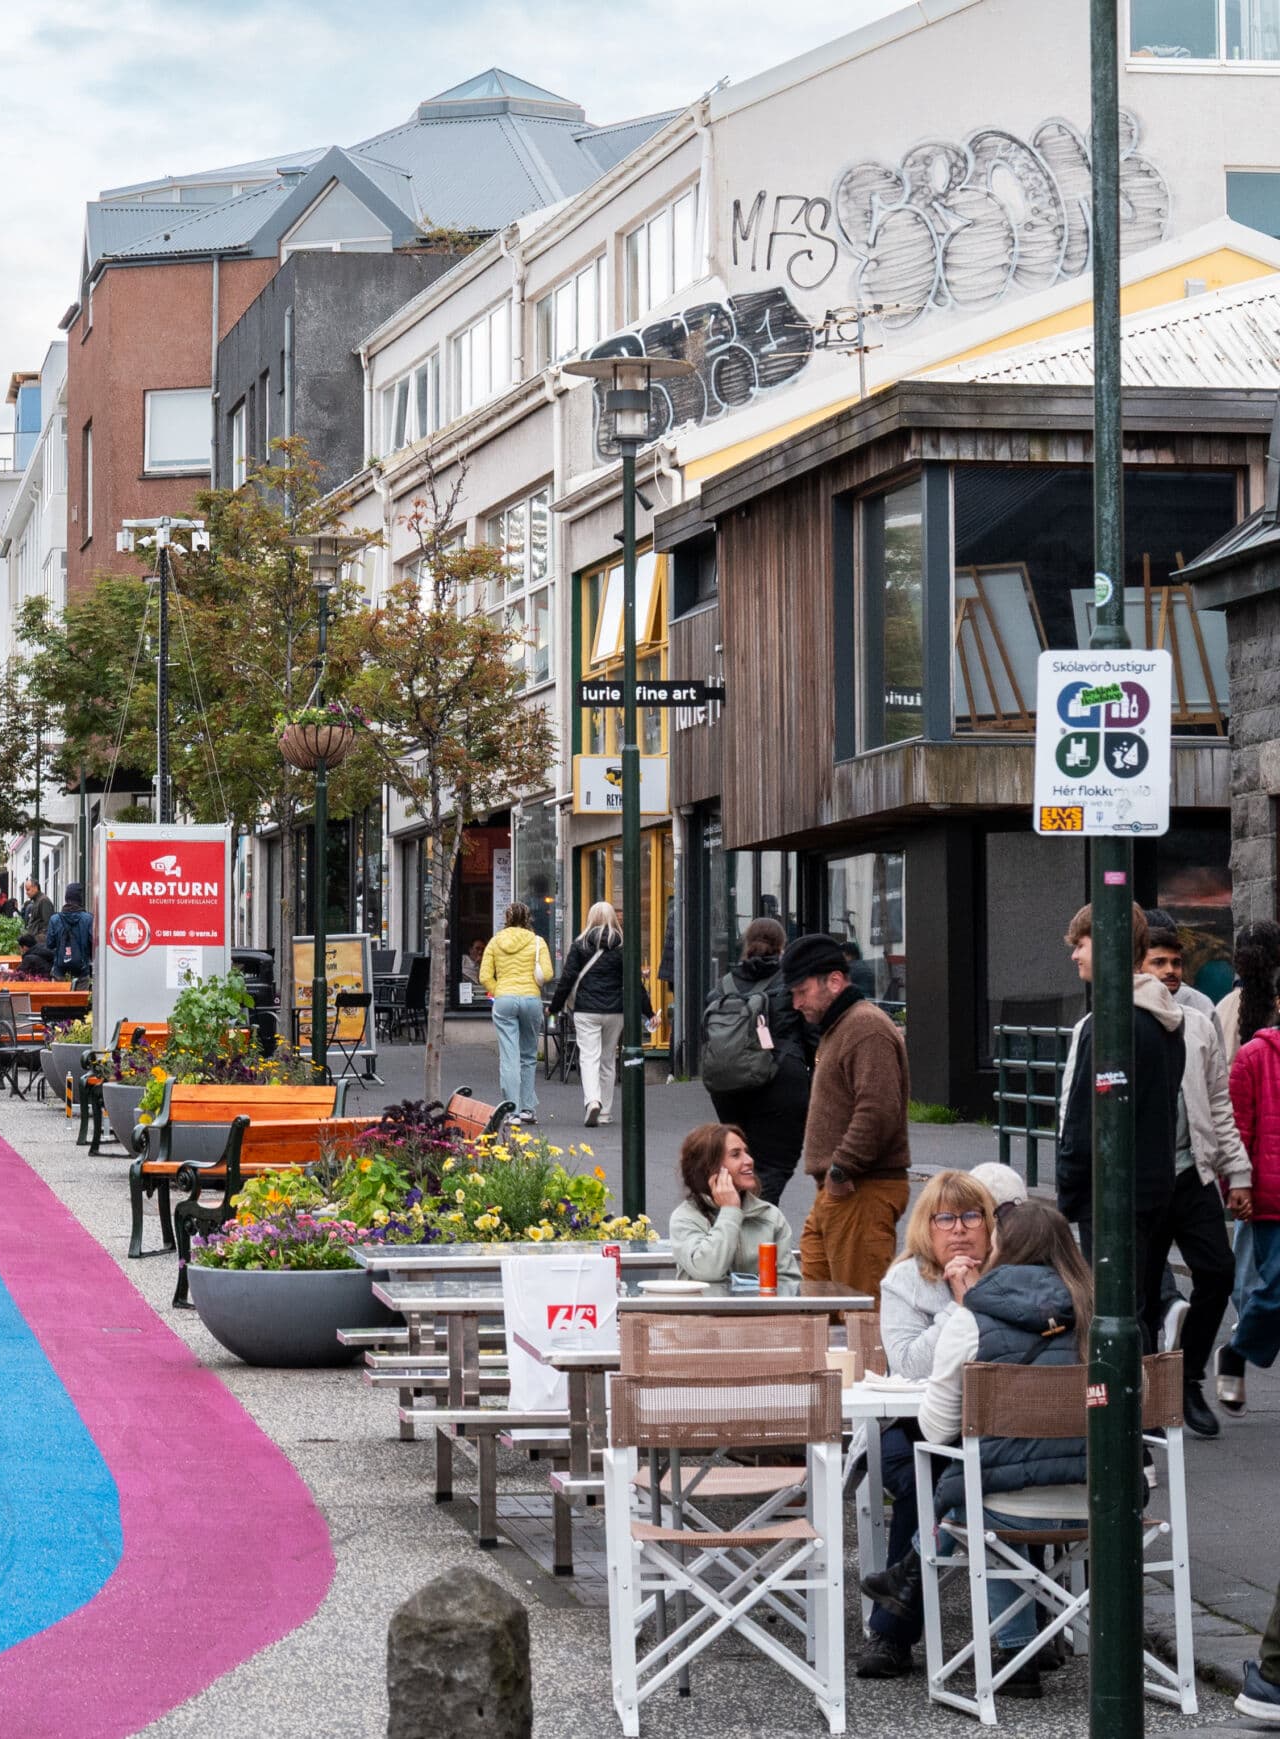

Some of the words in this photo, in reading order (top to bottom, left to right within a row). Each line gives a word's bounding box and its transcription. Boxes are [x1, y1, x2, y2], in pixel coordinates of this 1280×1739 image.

[582, 686, 621, 700] iurie
[635, 686, 668, 700] fine
[672, 687, 696, 700] art
[1053, 785, 1077, 796] Hér
[113, 881, 218, 896] VARÐTURN
